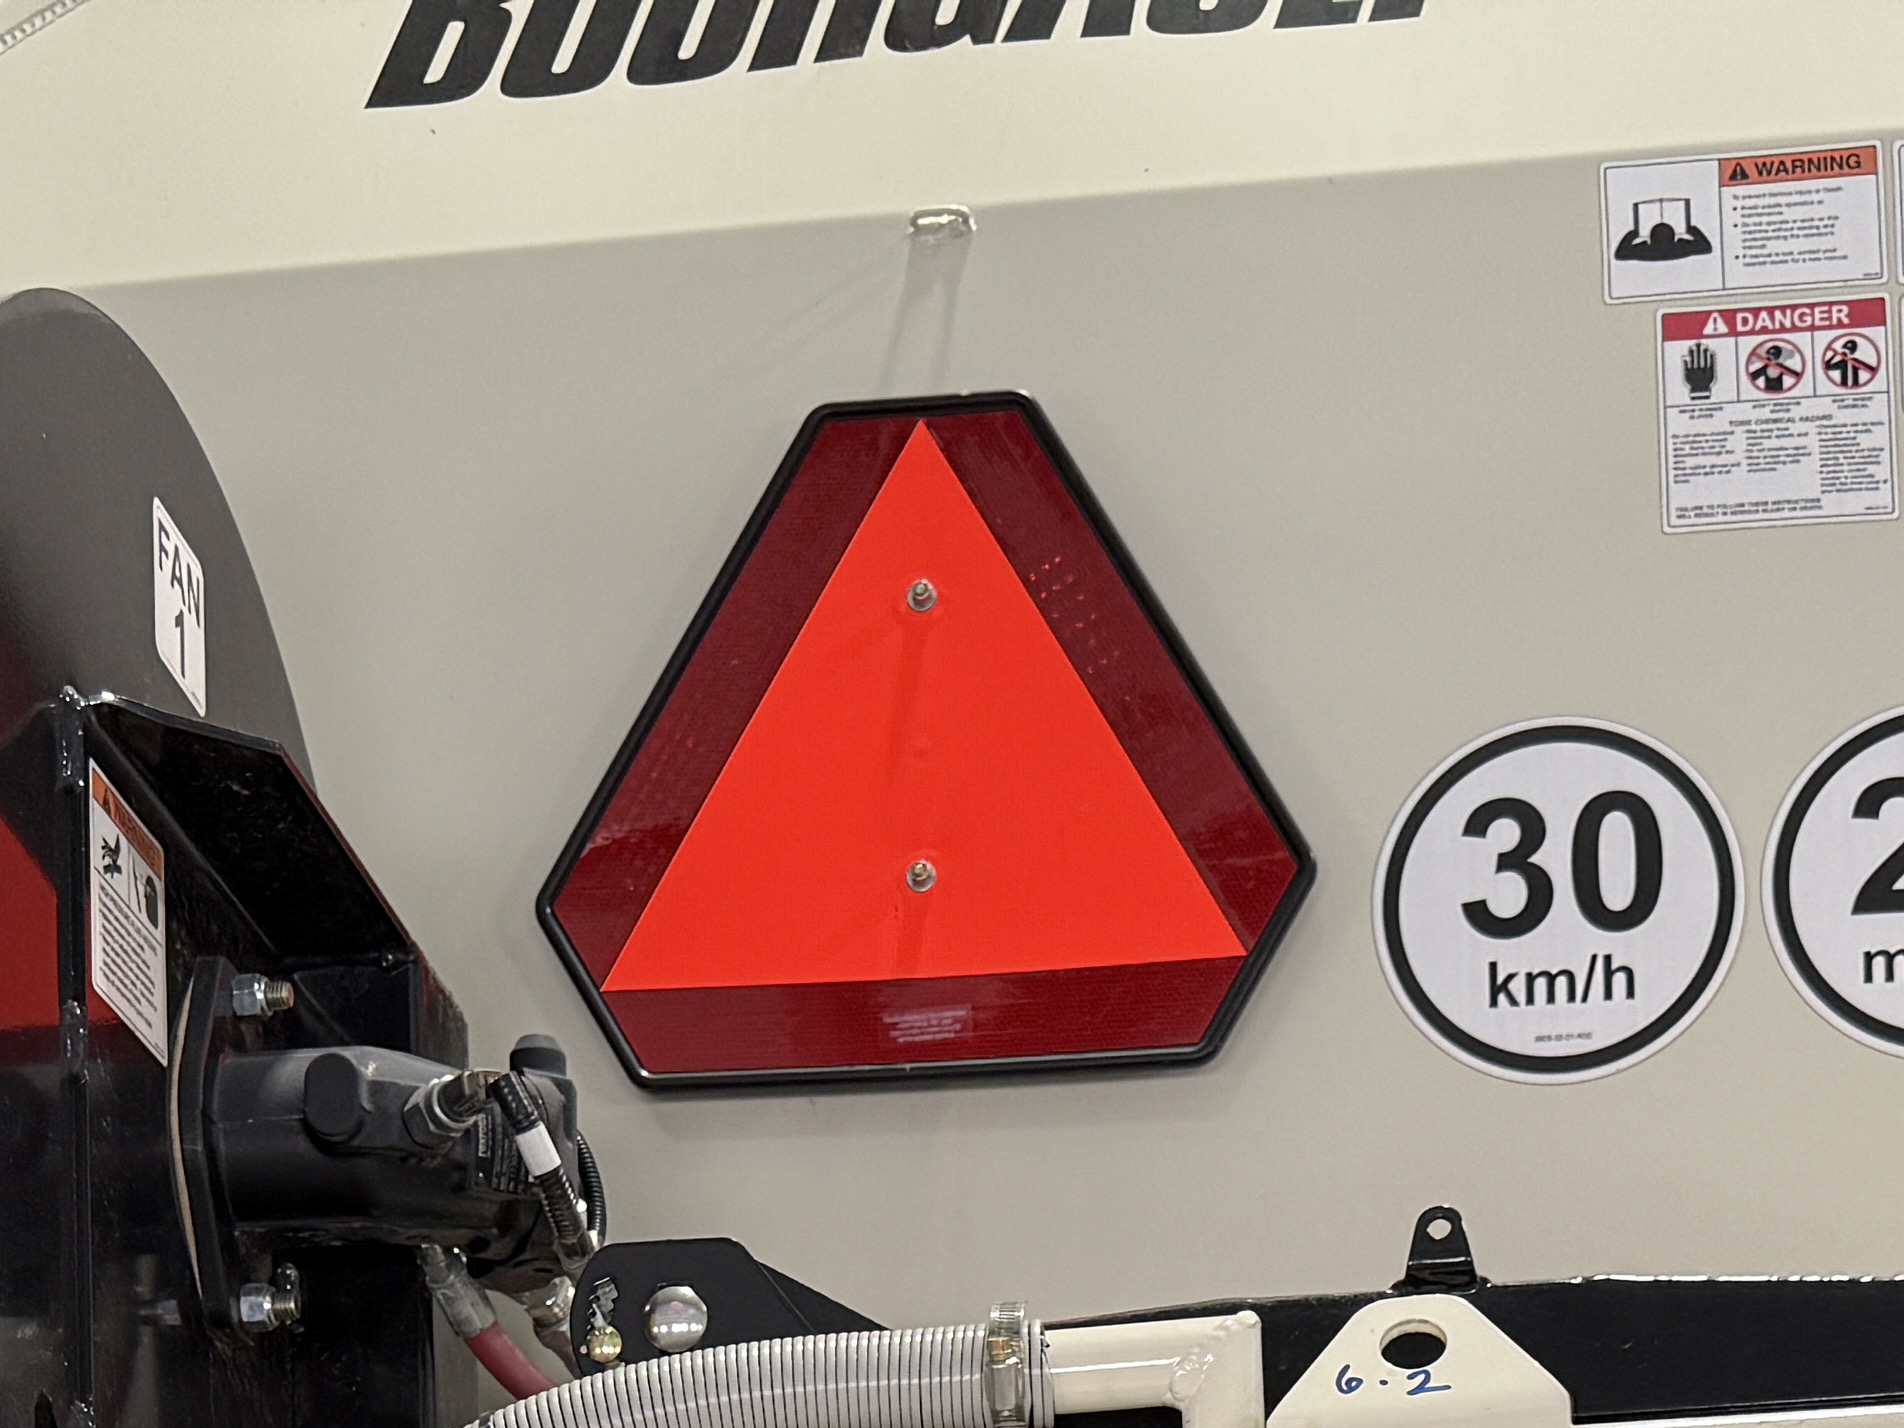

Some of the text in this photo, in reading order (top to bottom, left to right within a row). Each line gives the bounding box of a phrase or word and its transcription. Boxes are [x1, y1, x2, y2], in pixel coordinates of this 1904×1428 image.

[1755, 153, 1861, 176] WARNING
[1736, 305, 1849, 332] DANGER
[158, 517, 200, 628] FAN
[175, 609, 185, 680] 1
[1461, 790, 1664, 941] 30
[1487, 954, 1636, 1009] km/h
